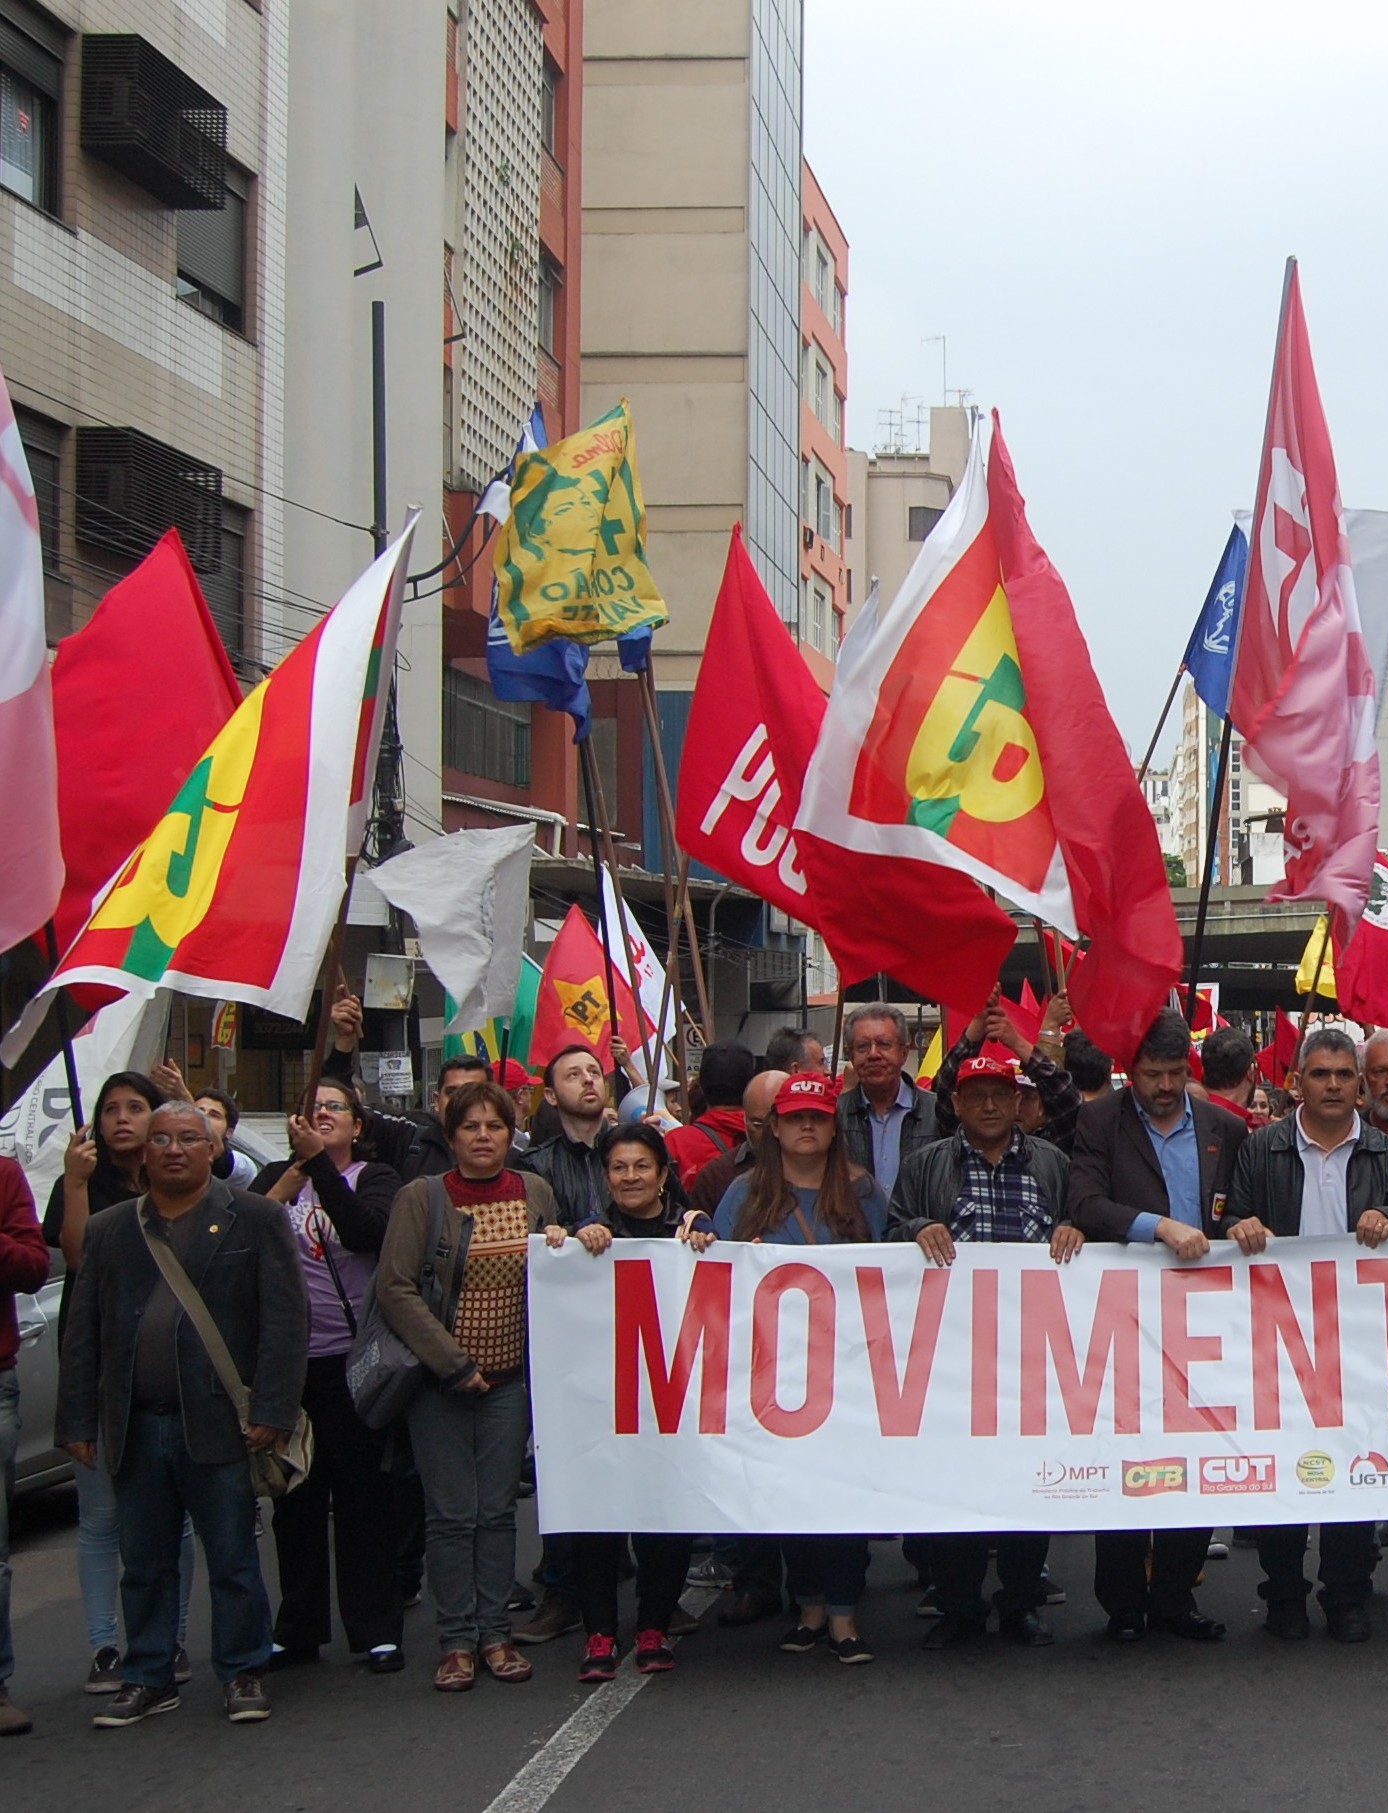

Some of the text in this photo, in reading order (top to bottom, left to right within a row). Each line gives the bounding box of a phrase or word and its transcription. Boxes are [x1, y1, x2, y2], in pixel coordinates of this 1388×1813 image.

[571, 989, 601, 1022] PT
[790, 1081, 823, 1094] CUT
[1069, 1466, 1110, 1481] MPT
[1125, 1465, 1184, 1489] CTB
[1202, 1457, 1272, 1484] CUT
[1216, 1484, 1247, 1492] Grande
[1249, 1483, 1260, 1491] do
[1262, 1482, 1273, 1491] Sul
